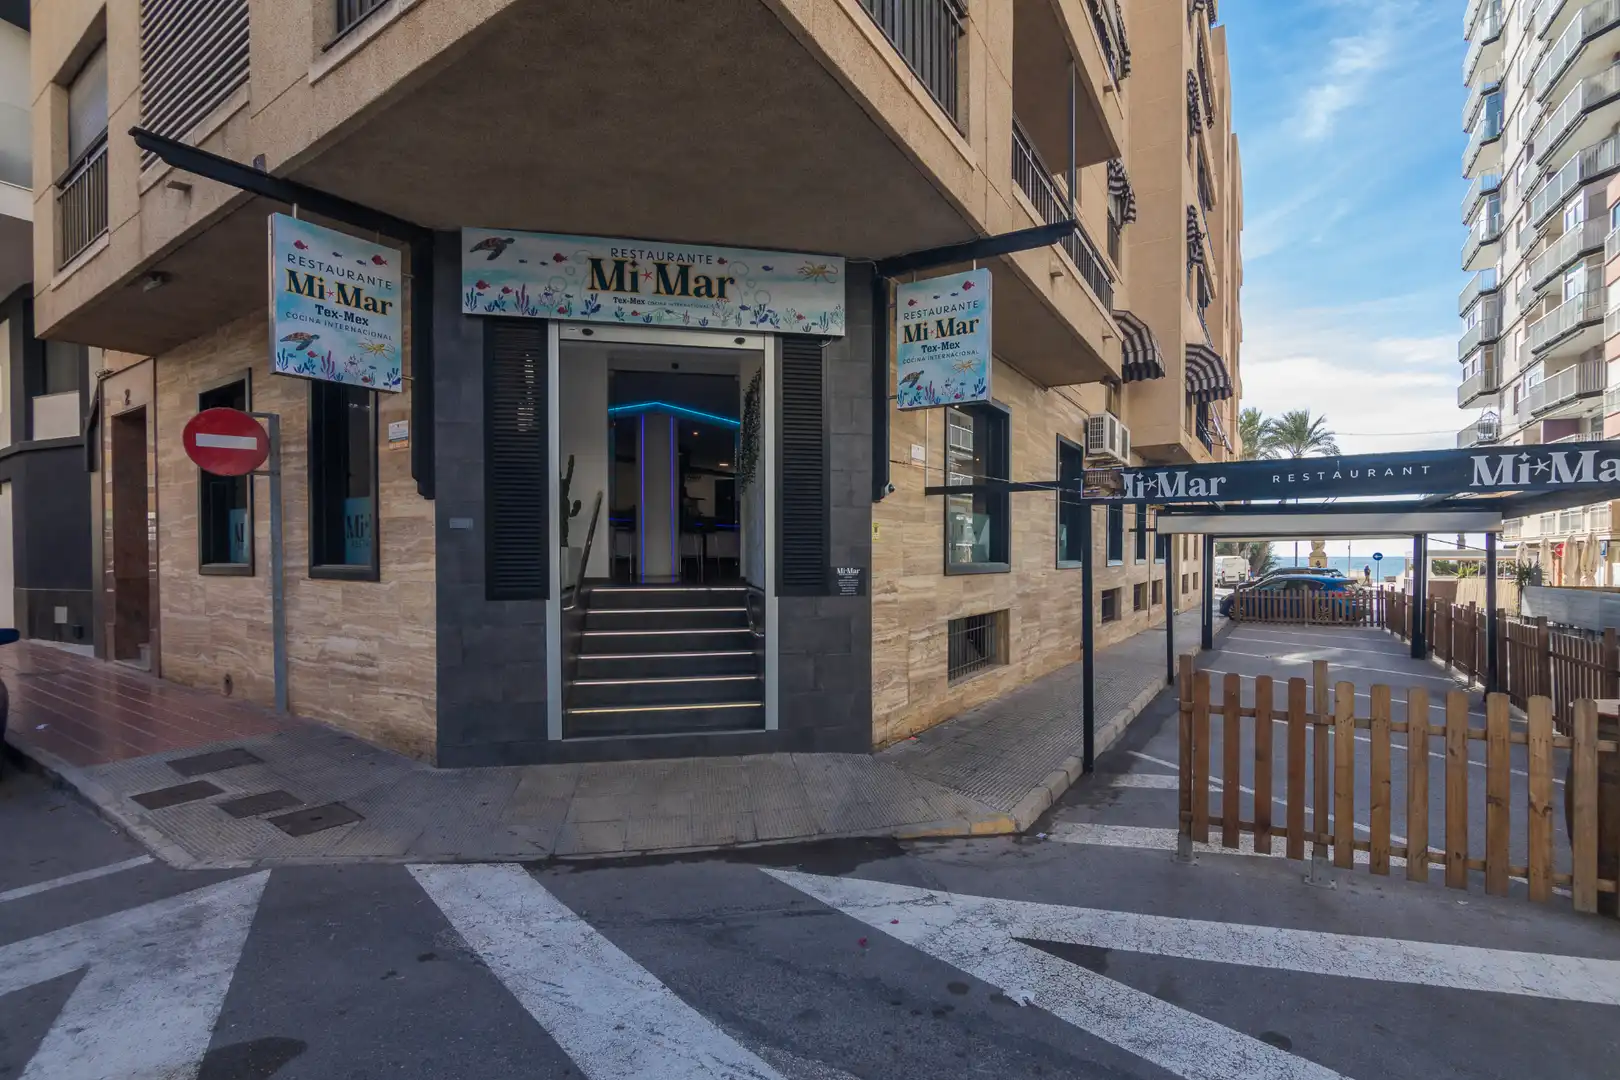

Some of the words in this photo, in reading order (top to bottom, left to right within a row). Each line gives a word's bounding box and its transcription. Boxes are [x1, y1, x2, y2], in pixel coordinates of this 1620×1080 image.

[610, 248, 713, 265] RESTAURANTE
[287, 253, 392, 290] RESTAURANTE
[586, 257, 641, 293] Mi
[652, 261, 736, 299] Mar
[285, 268, 326, 300] Mi
[335, 281, 393, 316] Mar
[613, 296, 646, 306] Tex-Mex
[315, 304, 369, 326] Tex-Mex
[903, 300, 979, 320] RESTAURANTE
[285, 311, 321, 325] COCINA
[324, 319, 393, 341] INTERNACIONAL
[902, 322, 929, 344] Mi
[935, 317, 980, 339] Mar
[921, 341, 960, 353] Tex-Mex
[902, 356, 926, 365] COCINA
[1155, 471, 1227, 498] Mar
[1272, 465, 1431, 484] RESTAURANT
[1469, 452, 1532, 487] Mi
[1546, 450, 1620, 484] Ma
